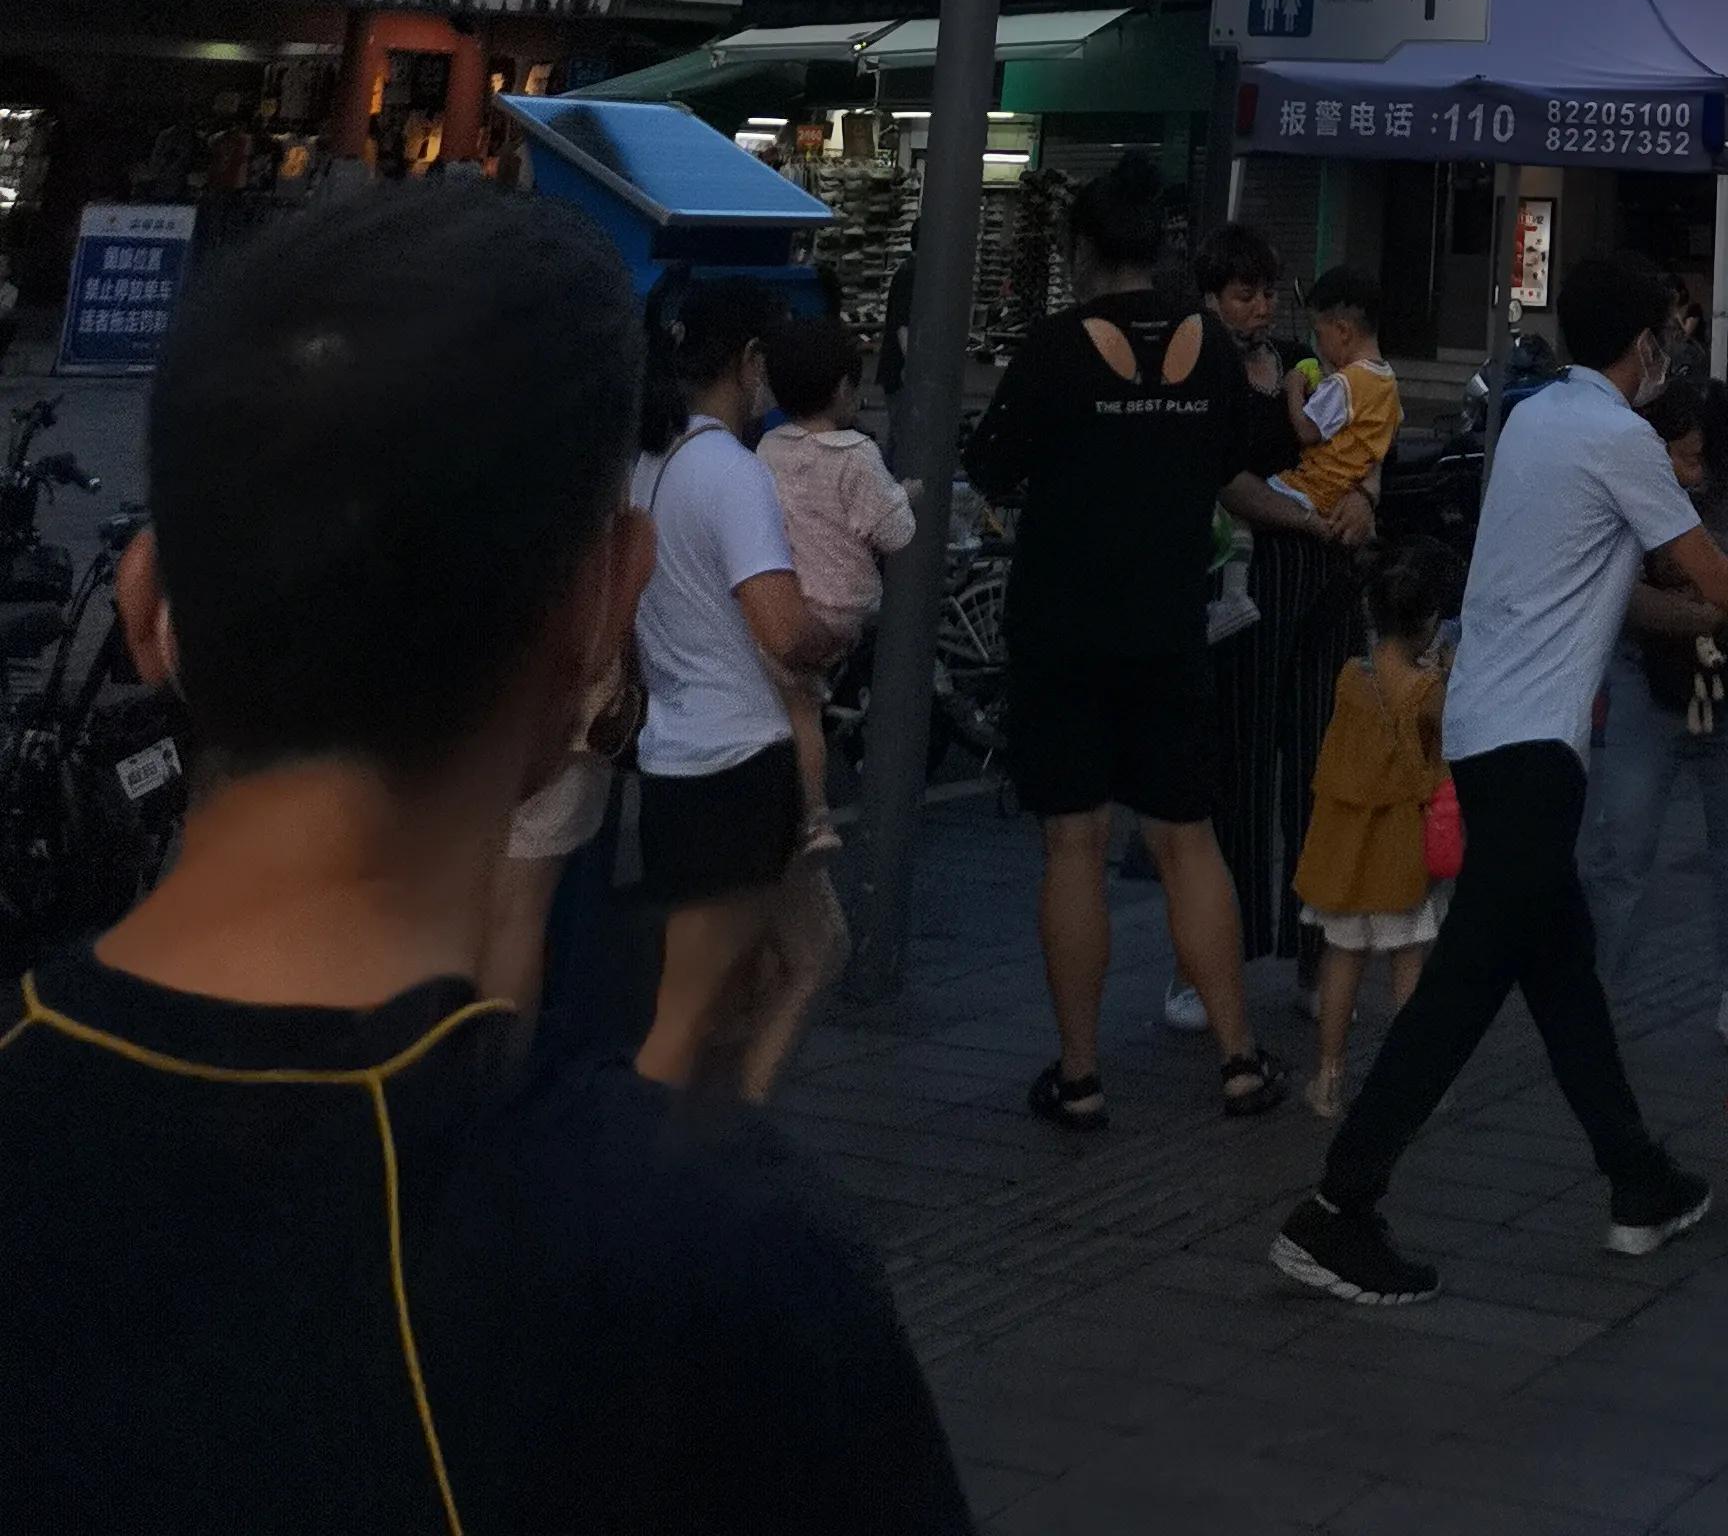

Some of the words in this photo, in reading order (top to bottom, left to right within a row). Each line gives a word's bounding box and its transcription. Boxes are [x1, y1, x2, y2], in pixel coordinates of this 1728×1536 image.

[1546, 99, 1691, 128] 82205100
[1545, 128, 1690, 156] 82237352
[1095, 400, 1122, 414] THE
[1126, 399, 1162, 413] BEST
[1166, 398, 1209, 413] PLACE
